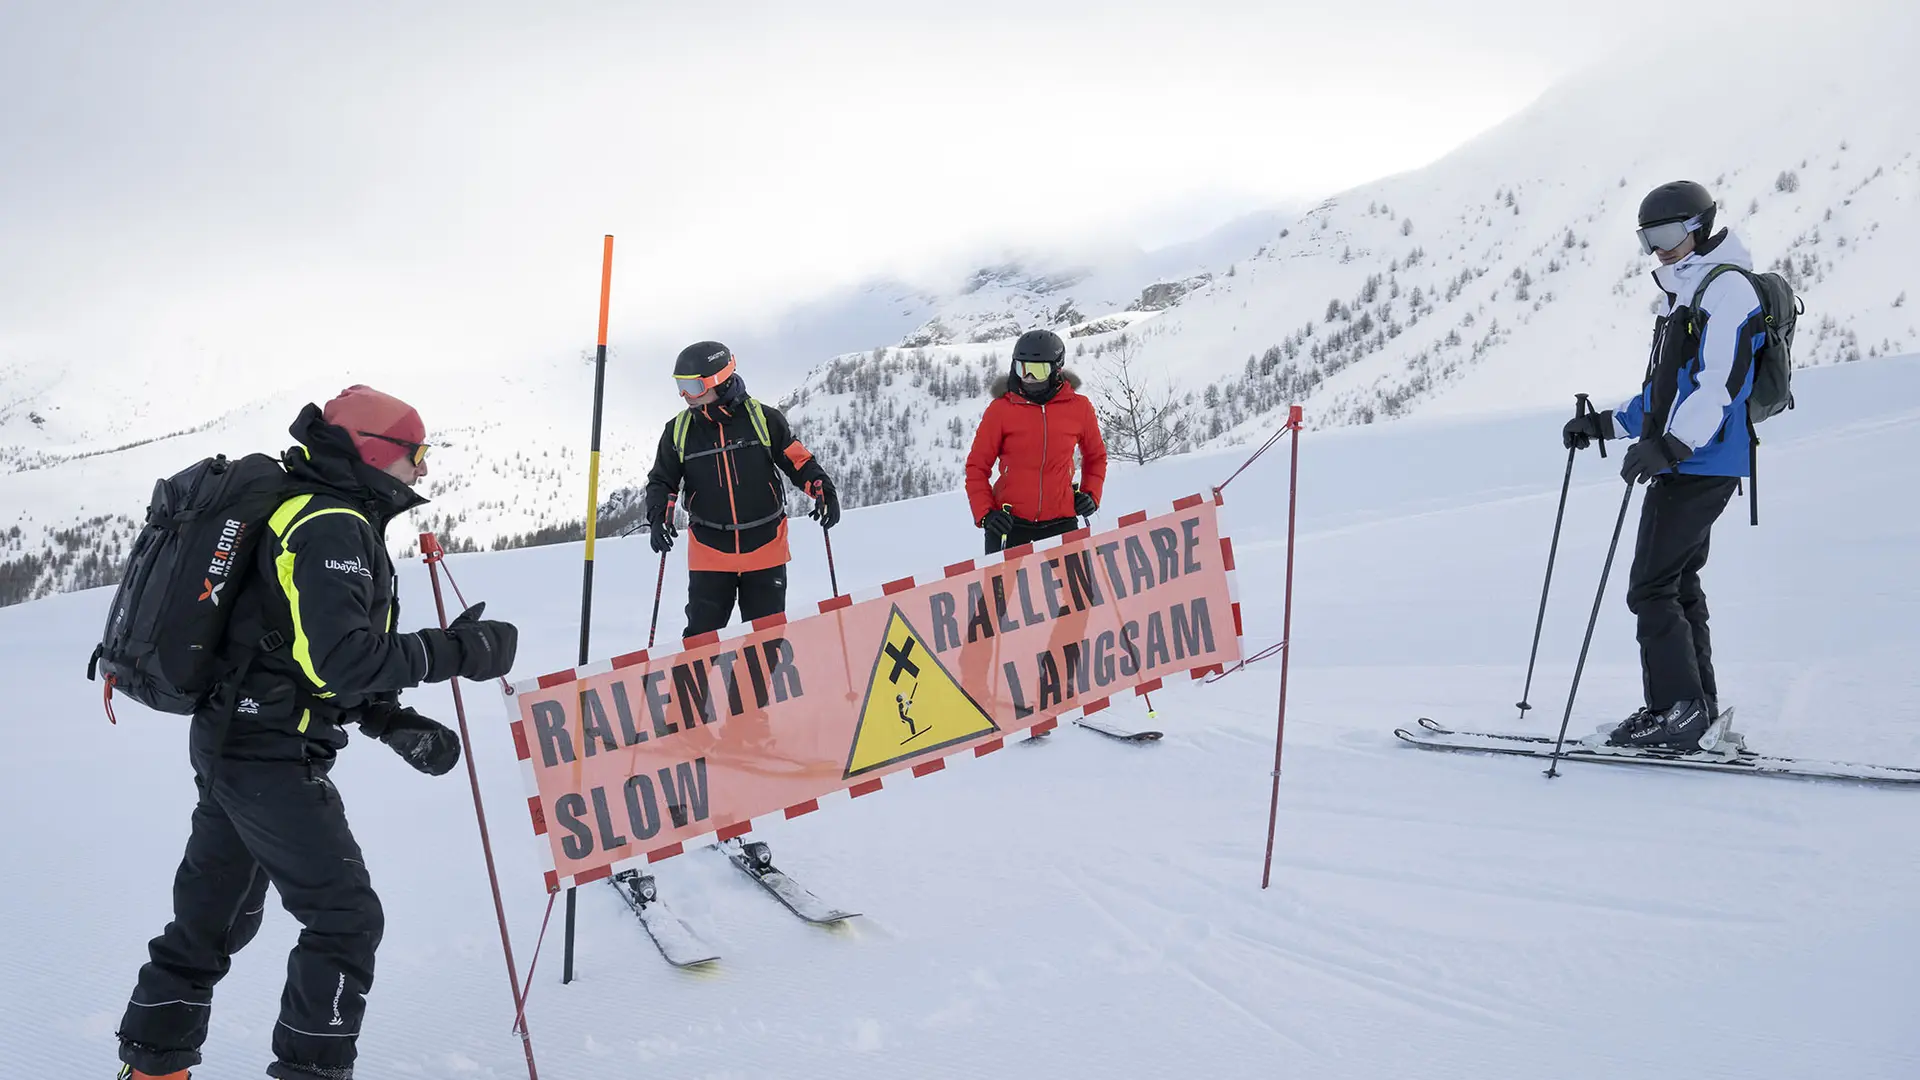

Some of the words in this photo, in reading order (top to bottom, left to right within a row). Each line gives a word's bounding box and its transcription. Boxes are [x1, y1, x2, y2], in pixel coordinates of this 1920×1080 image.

[208, 518, 241, 576] REACTOR
[223, 551, 237, 578] AIRBAG
[325, 559, 358, 574] Ubaye
[929, 516, 1202, 654] RALLENTARE
[530, 637, 804, 768] RALENTIR
[1003, 597, 1217, 721] LANGSAM
[554, 757, 710, 860] SLOW
